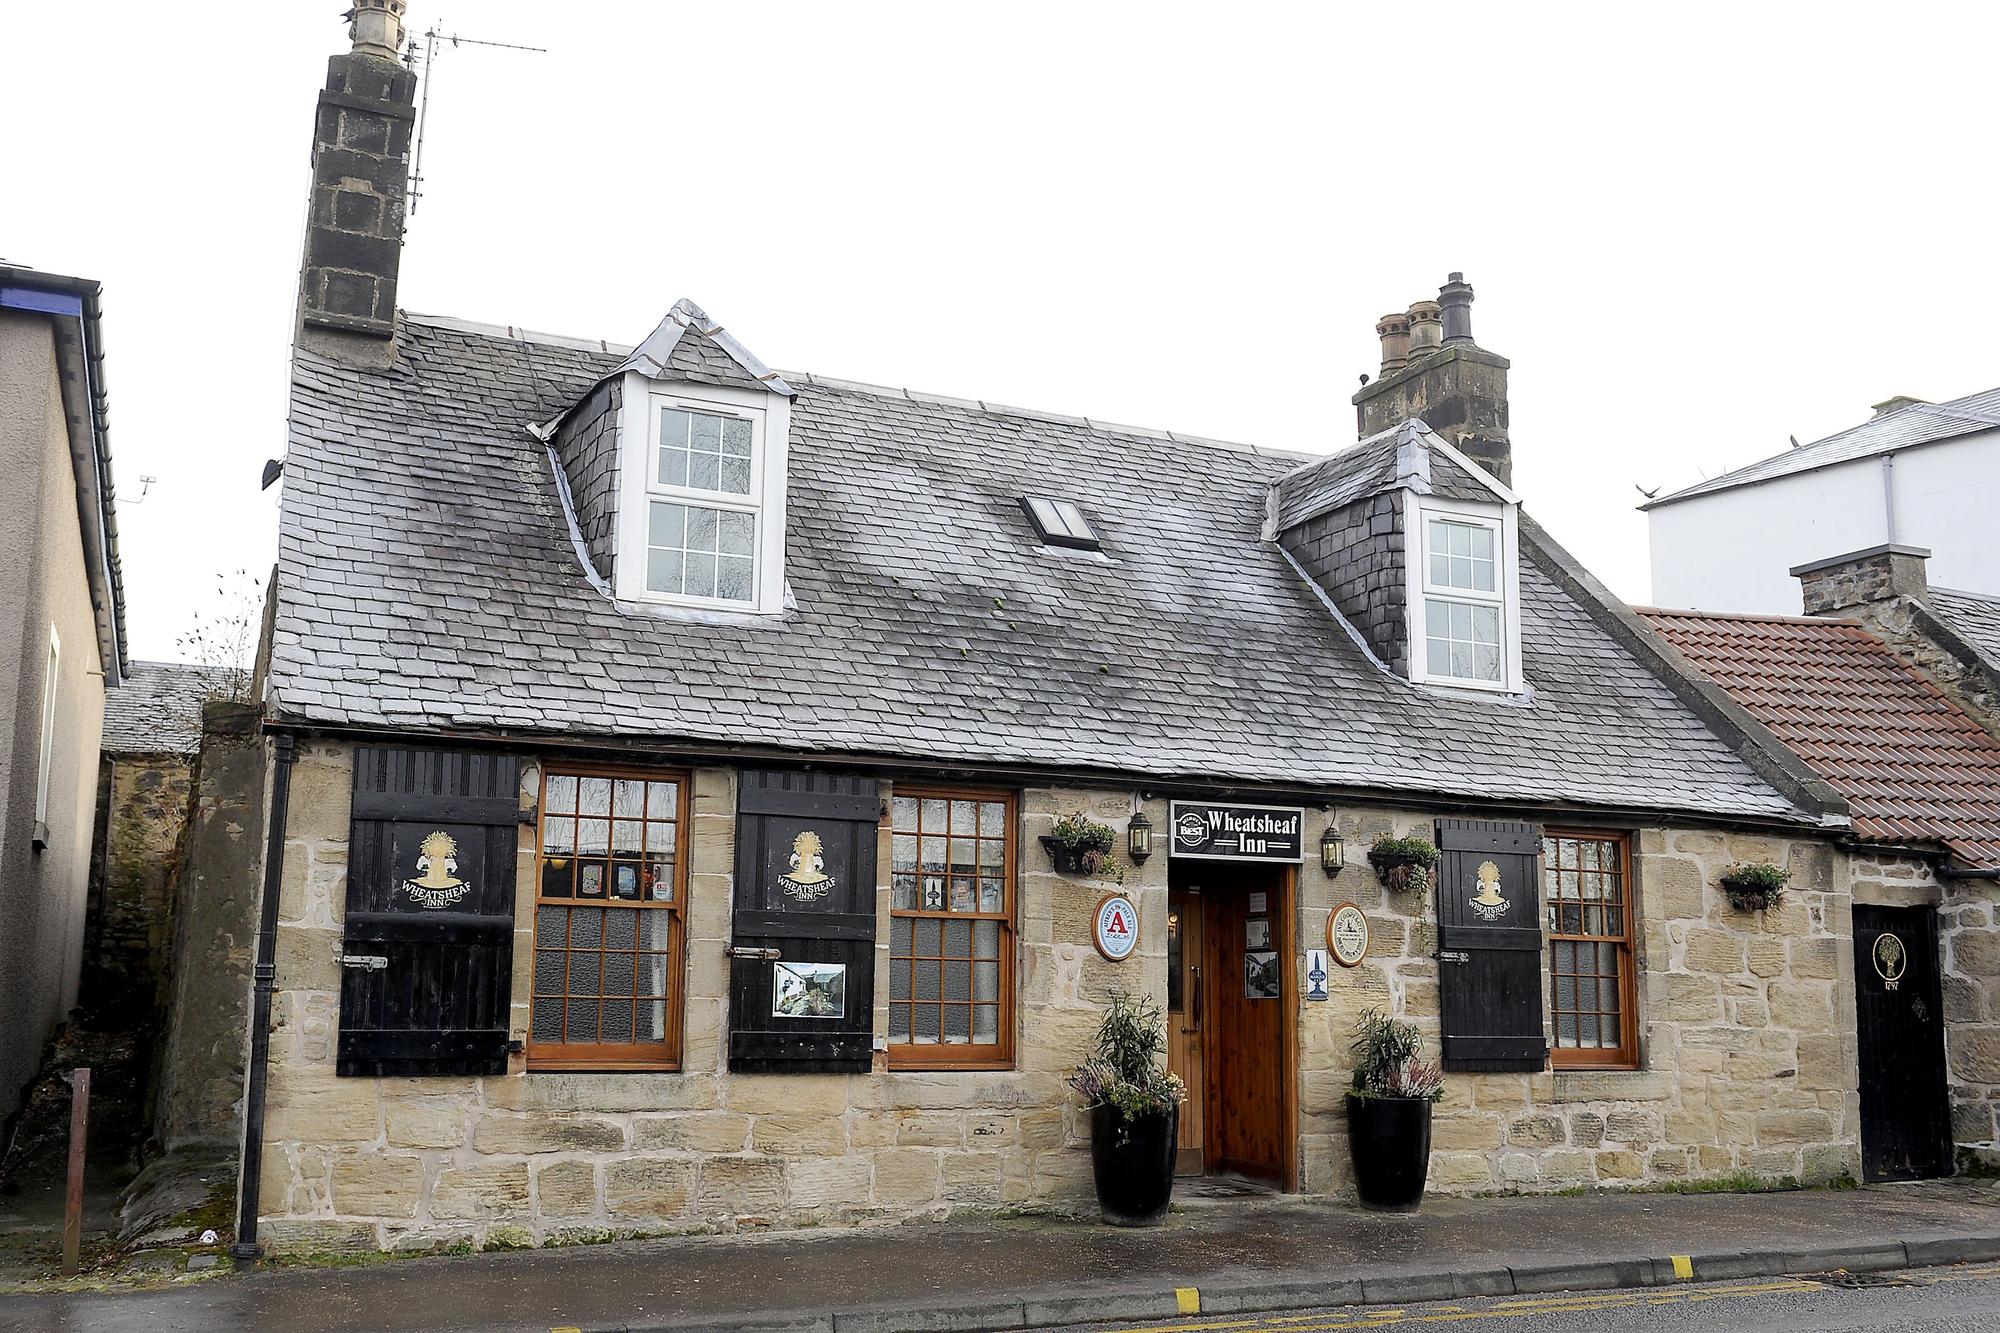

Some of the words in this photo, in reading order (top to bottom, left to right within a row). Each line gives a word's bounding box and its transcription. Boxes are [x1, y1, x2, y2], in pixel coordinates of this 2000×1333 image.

[1180, 826, 1204, 836] BEST
[1207, 810, 1298, 835] Wheatsheaf
[1239, 832, 1267, 853] Inn
[402, 880, 471, 899] WHEATSHEAF
[777, 875, 836, 893] WHEATSHEAF
[426, 899, 444, 907] INN
[798, 892, 813, 900] INN
[1468, 897, 1511, 914] WHEATSHEAF
[1106, 911, 1129, 934] A
